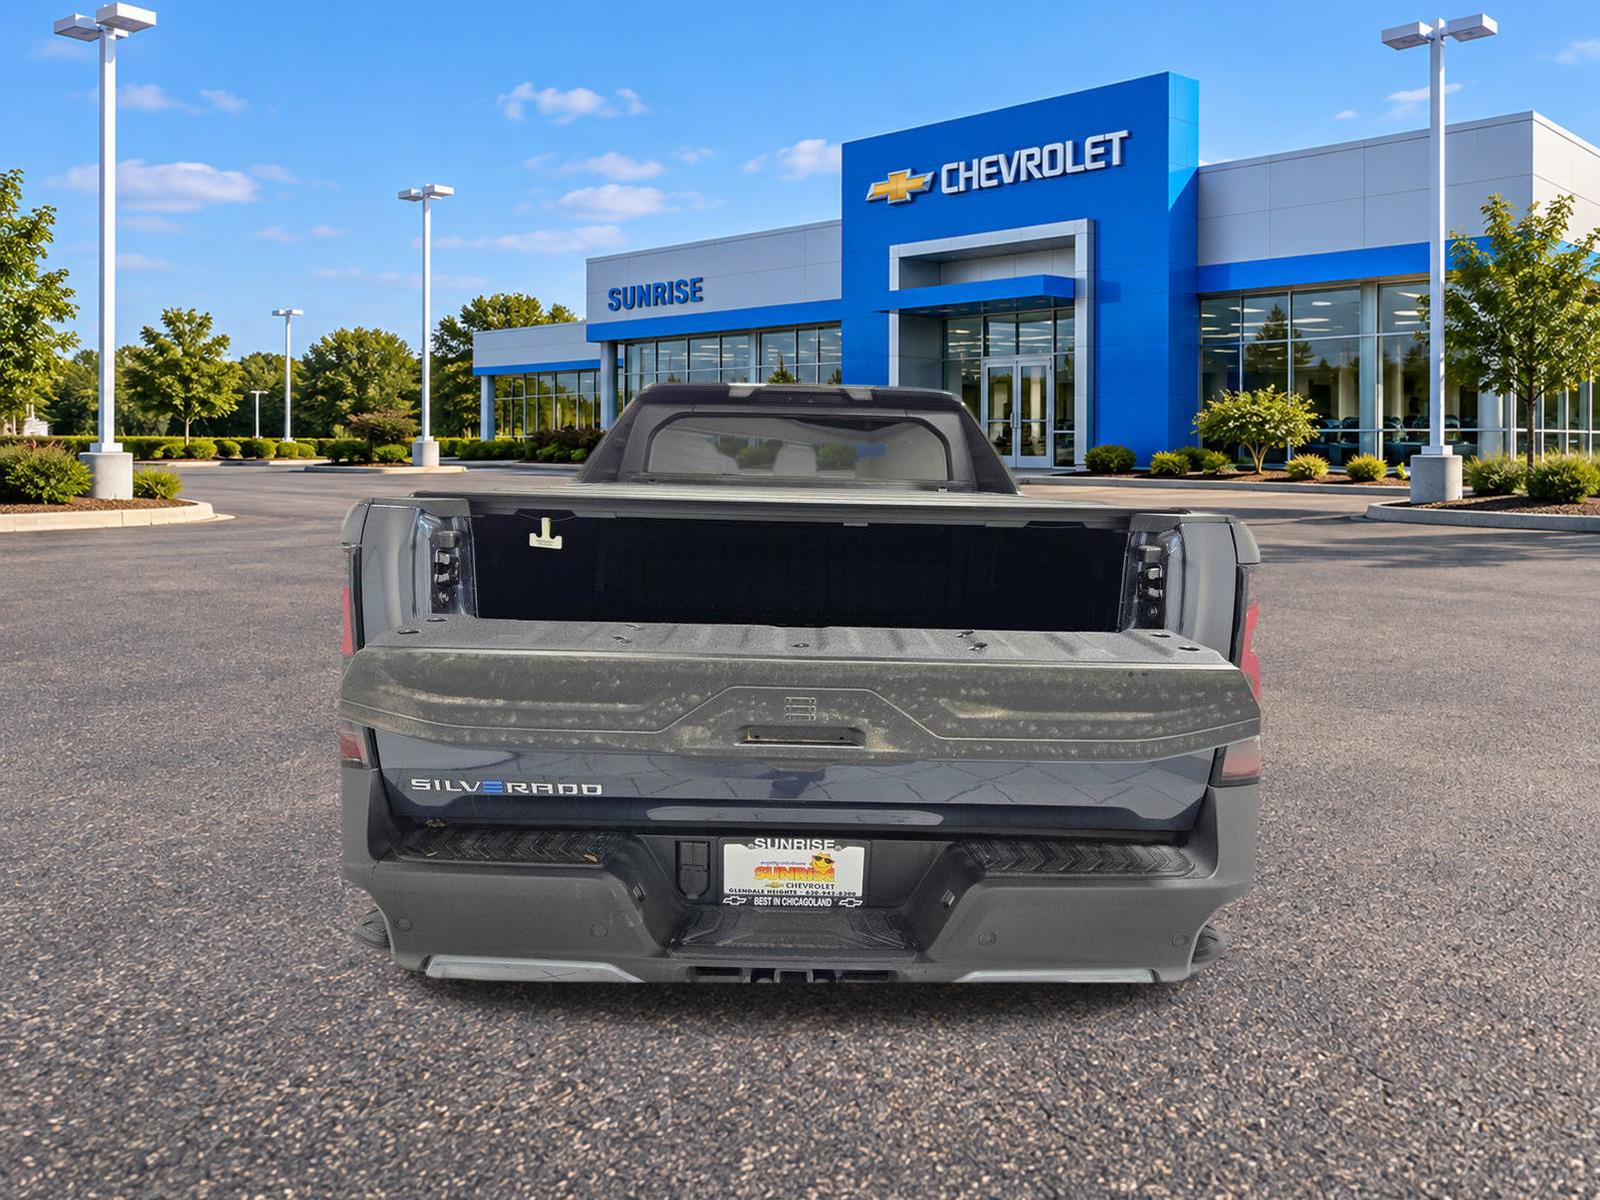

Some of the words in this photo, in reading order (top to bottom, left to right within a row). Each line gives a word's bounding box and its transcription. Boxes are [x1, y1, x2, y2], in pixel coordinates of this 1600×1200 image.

[941, 130, 1129, 194] CHEVROLET
[607, 276, 704, 312] SUNRISE
[411, 778, 603, 796] SILVERADO
[754, 837, 835, 851] SUNRISE
[786, 882, 835, 890] CHEVROLET
[754, 896, 772, 906] BEST
[773, 896, 780, 906] IN
[781, 896, 832, 907] CHICAGOLAND
